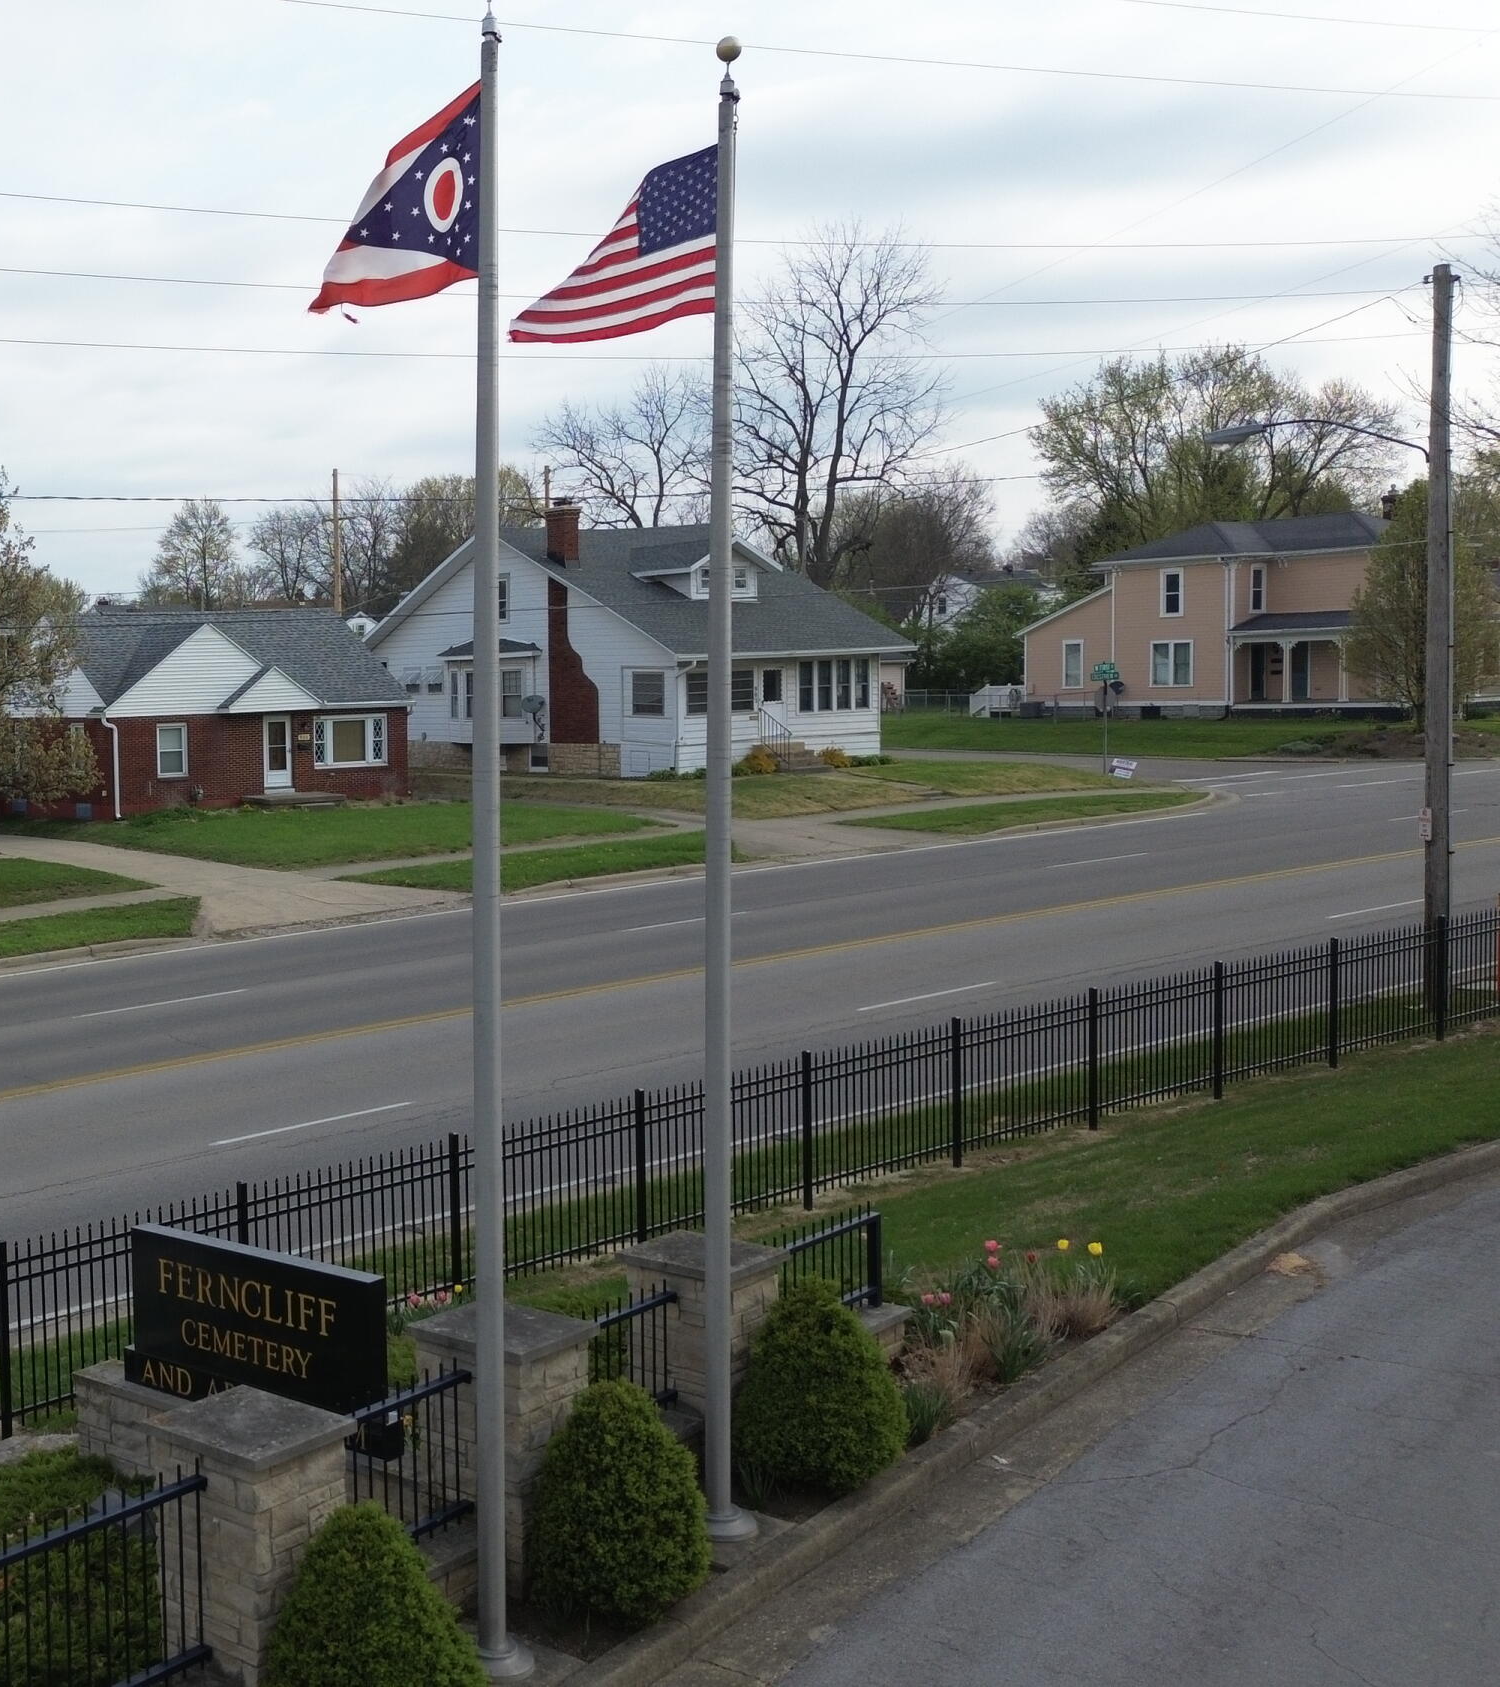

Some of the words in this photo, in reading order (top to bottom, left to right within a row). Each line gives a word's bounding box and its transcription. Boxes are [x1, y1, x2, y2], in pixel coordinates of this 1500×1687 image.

[158, 1258, 337, 1337] FERNCLIFF
[141, 1359, 192, 1396] AND
[181, 1318, 313, 1379] CEMETERY
